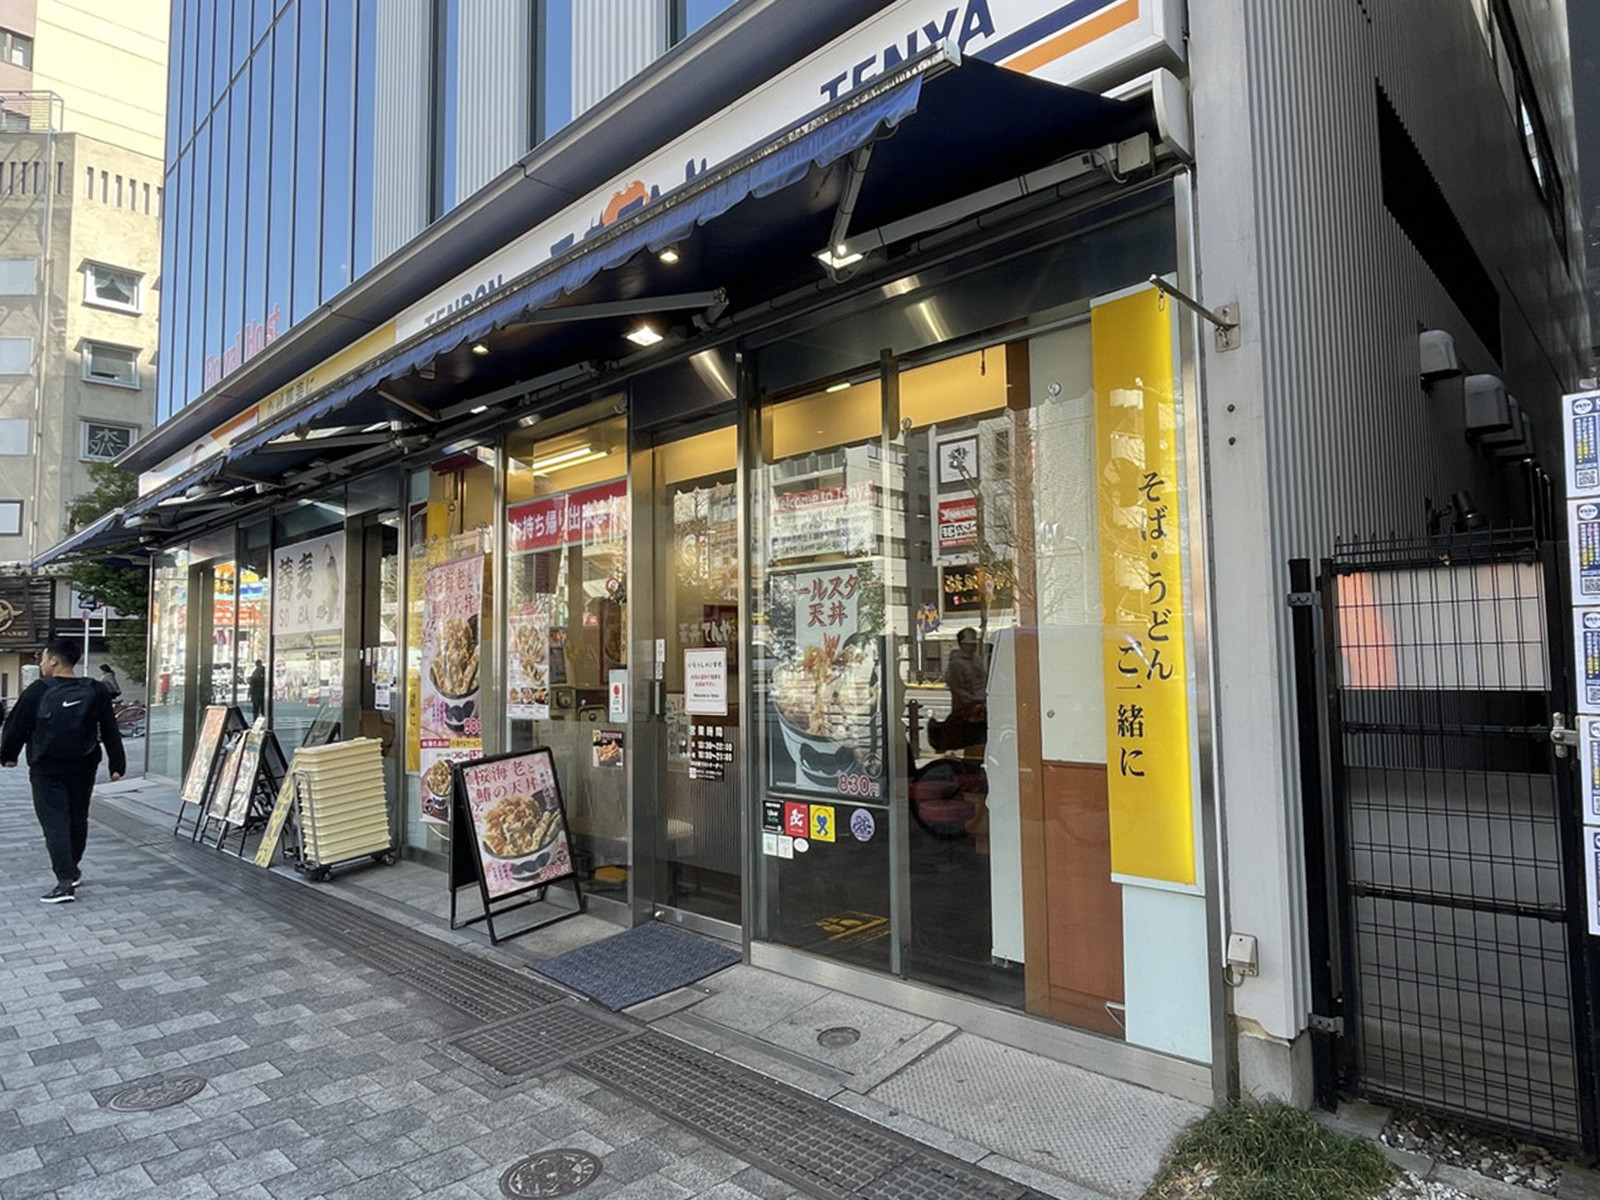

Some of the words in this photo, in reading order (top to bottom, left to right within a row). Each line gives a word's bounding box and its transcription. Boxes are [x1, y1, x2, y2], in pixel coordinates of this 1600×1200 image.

[807, 600, 848, 628] 天丼
[1138, 470, 1173, 681] そば・うどん
[1115, 639, 1147, 778] ご一緒に
